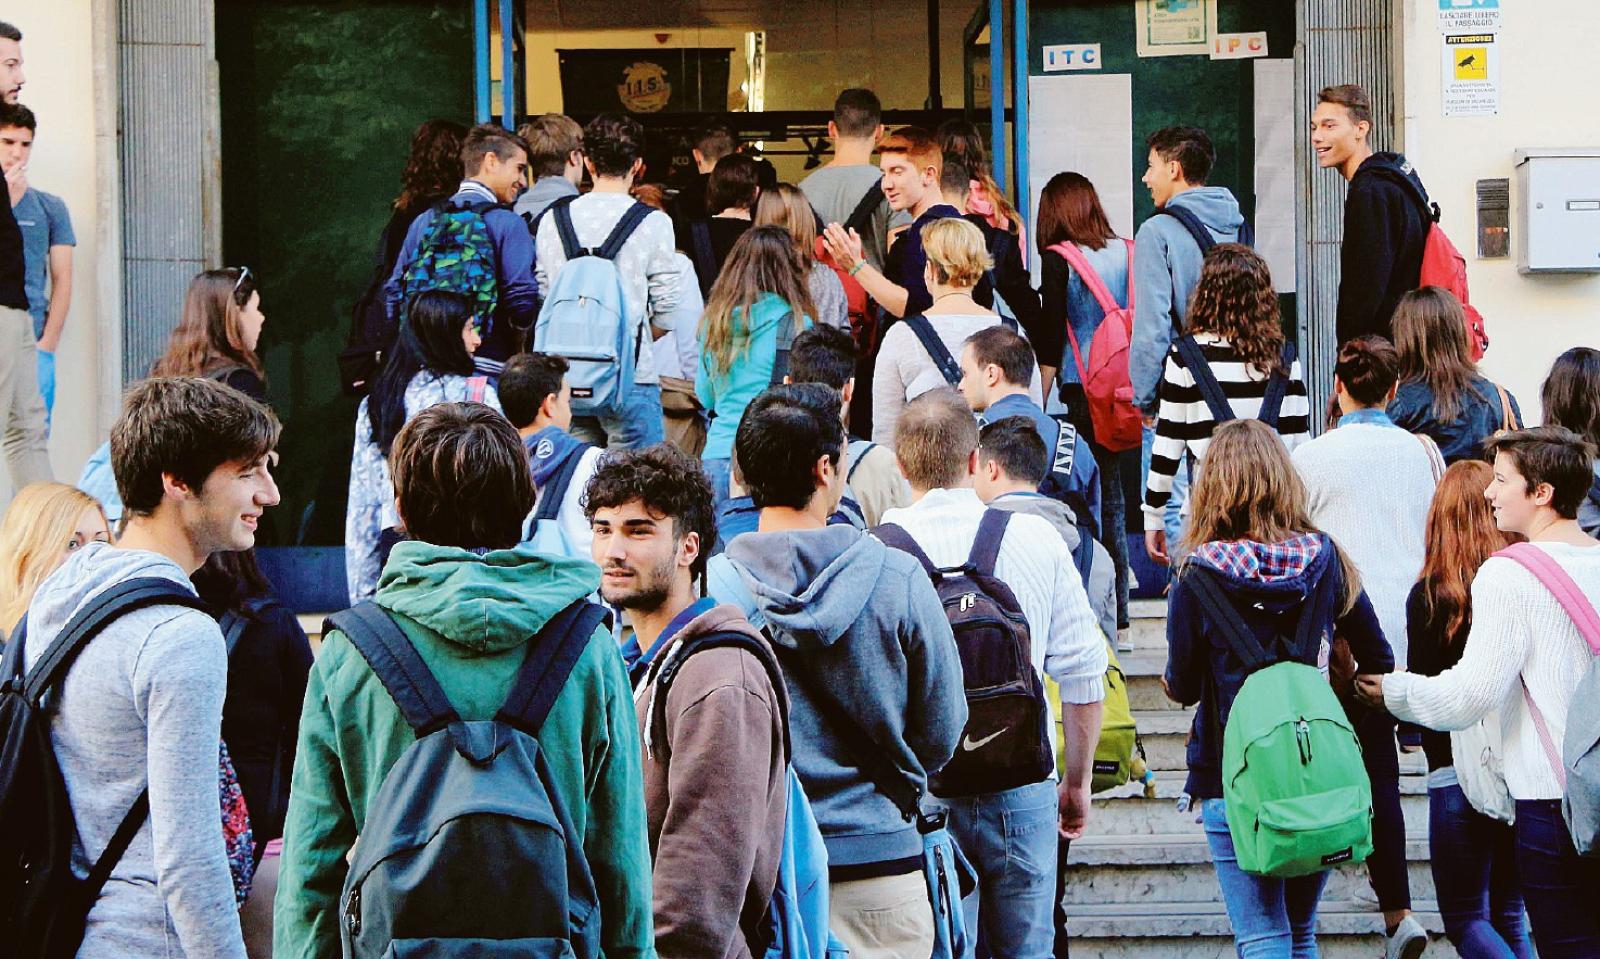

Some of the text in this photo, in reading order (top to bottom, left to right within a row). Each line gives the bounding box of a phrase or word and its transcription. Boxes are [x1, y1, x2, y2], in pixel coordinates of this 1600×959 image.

[1455, 19, 1493, 27] PASSAGGIO
[1215, 37, 1262, 53] IPC
[1049, 49, 1095, 64] ITC
